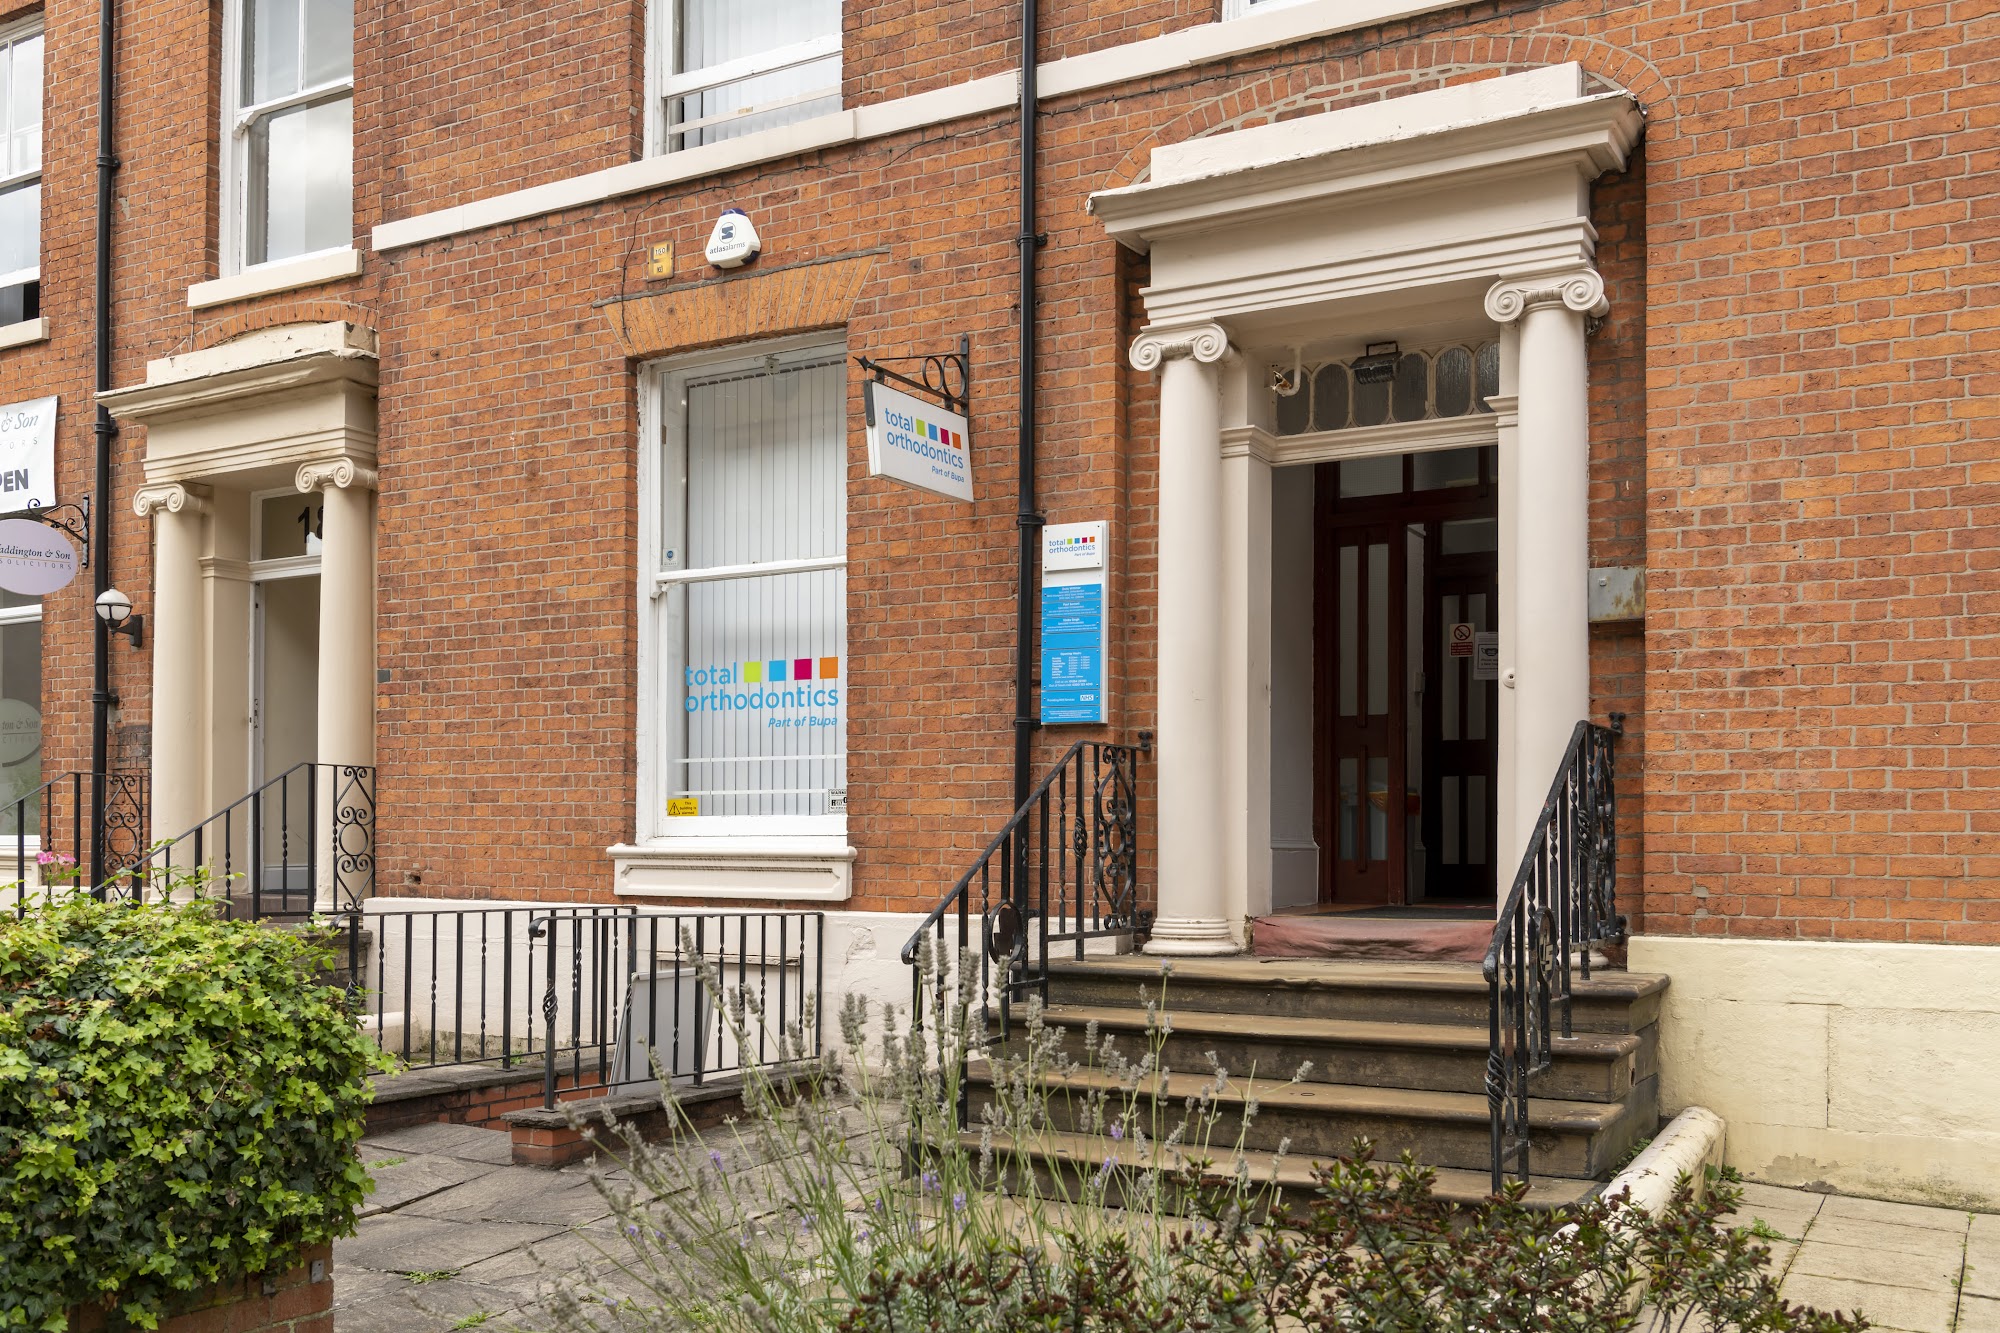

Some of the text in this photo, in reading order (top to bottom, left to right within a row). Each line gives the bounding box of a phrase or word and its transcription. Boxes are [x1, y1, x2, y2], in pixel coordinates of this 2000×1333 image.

[710, 242, 745, 254] atlasalarms
[14, 412, 39, 430] Son
[885, 408, 914, 433] total
[887, 432, 963, 469] orthodontics
[0, 469, 29, 492] EN
[932, 466, 943, 475] Part
[951, 472, 964, 482] Bupa
[0, 544, 71, 560] addington & Son
[1049, 544, 1095, 553] orthodontics
[685, 662, 737, 686] total
[685, 685, 838, 712] orthodontics
[25, 717, 38, 729] Son
[768, 716, 838, 728] Part of Bupa
